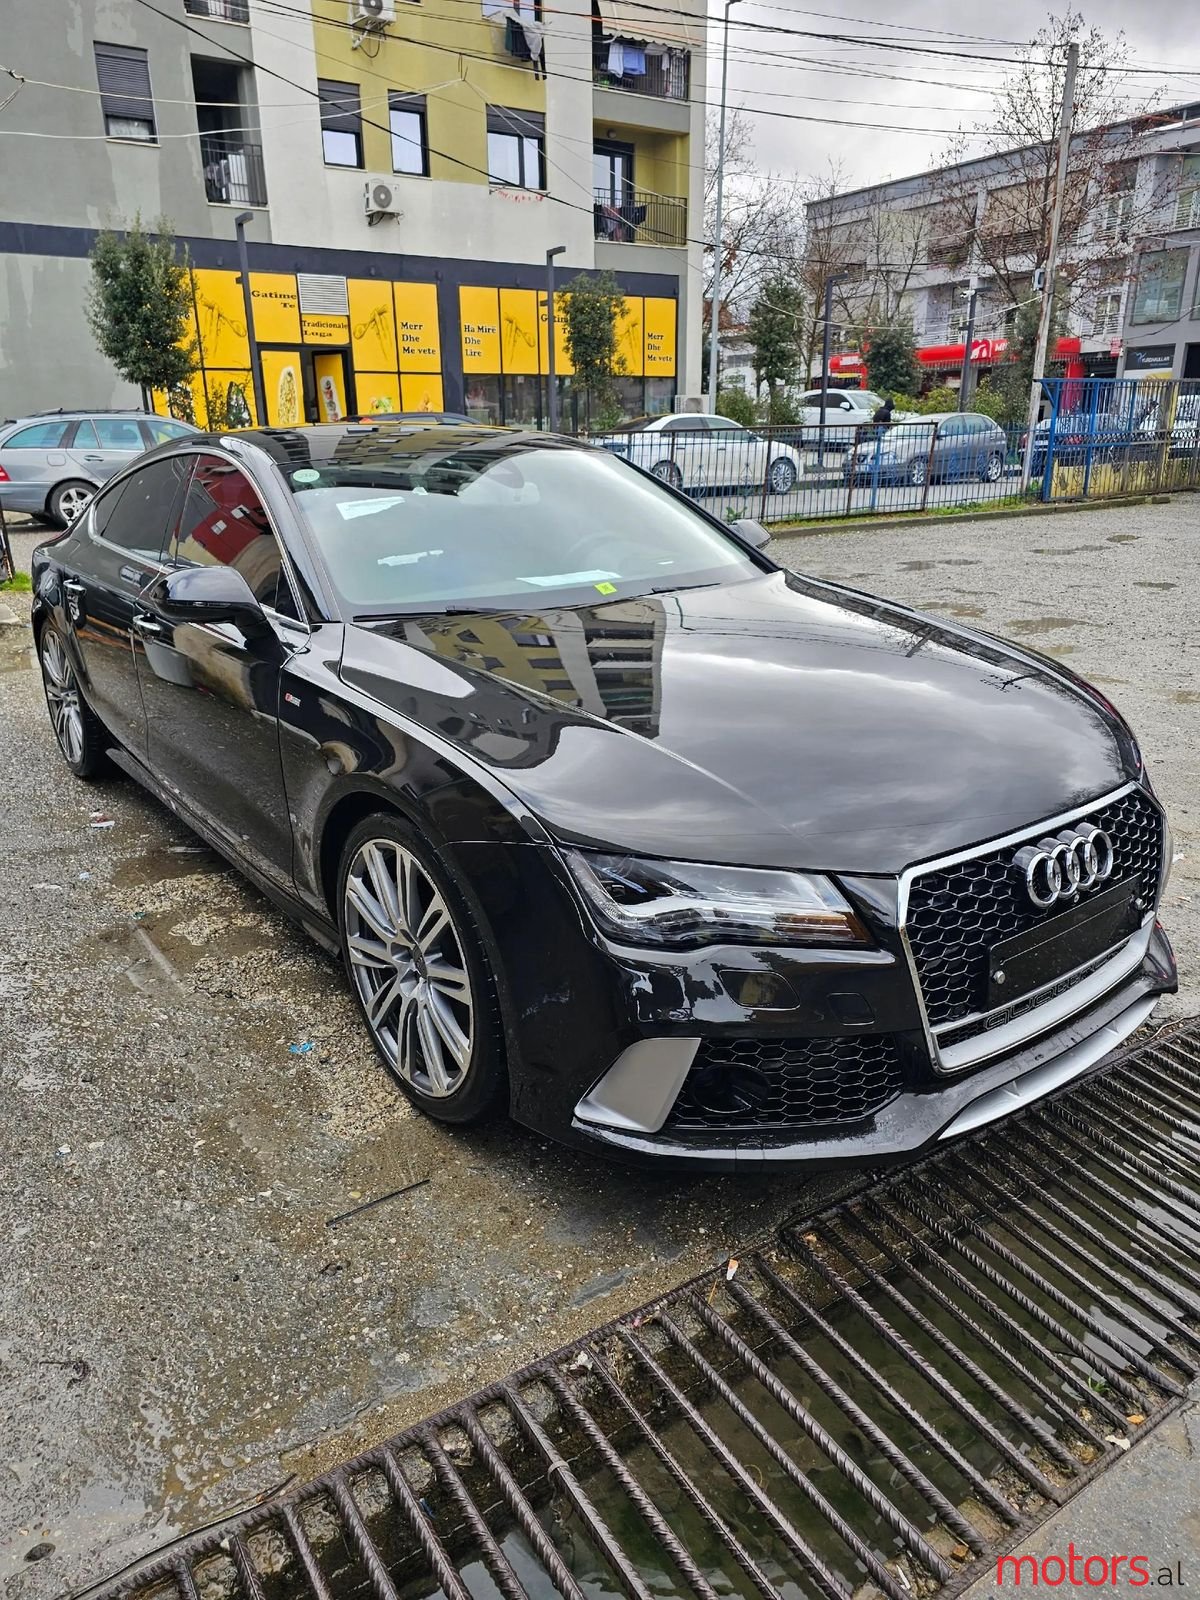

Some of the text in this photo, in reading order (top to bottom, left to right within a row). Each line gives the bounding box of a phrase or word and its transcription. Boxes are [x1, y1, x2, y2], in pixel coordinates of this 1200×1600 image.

[251, 290, 297, 300] Gatime
[400, 322, 423, 330] Merr
[464, 324, 475, 332] Ha
[401, 334, 420, 342] Dhe
[464, 336, 481, 344] Dhe
[402, 346, 436, 355] Me vete
